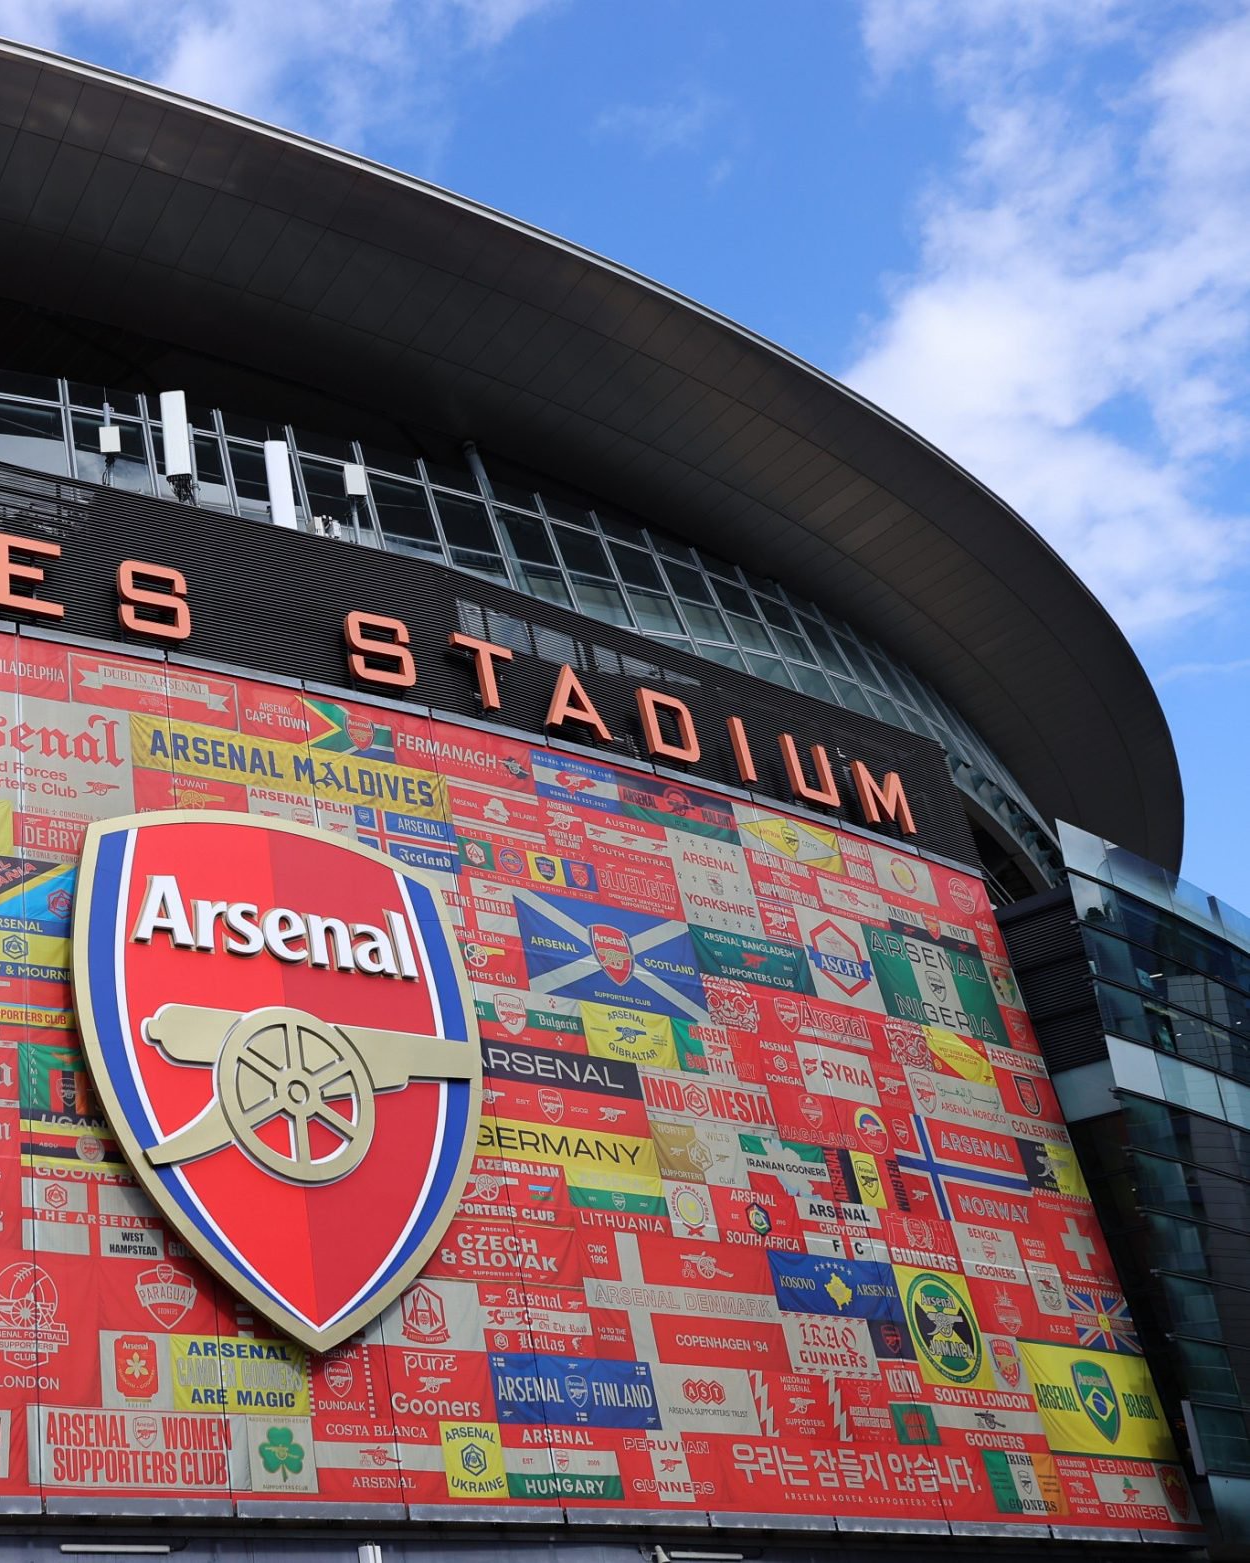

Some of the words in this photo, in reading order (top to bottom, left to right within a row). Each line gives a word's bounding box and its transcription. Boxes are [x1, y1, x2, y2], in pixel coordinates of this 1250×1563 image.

[344, 610, 917, 836] STADIUM
[397, 733, 497, 769] FERMANAGH
[13, 762, 67, 781] Forces
[150, 729, 283, 784] ARSENAL
[294, 756, 434, 807] MALDIVES
[41, 782, 78, 799] Club
[398, 818, 444, 837] ARSENAL
[683, 851, 739, 873] ARSENAL
[685, 893, 756, 918] YORKSHIRE
[129, 874, 420, 984] Arsenal
[531, 936, 579, 953] ARSENAL
[644, 958, 695, 975] SCOTLAND
[45, 1012, 66, 1024] CLUB
[894, 990, 997, 1041] NIGERIA
[609, 1042, 657, 1060] GIBRALTAR
[822, 1060, 873, 1088] SYRIA
[477, 1124, 641, 1167] GERMANY
[747, 1157, 784, 1172] IRANIAN
[786, 1165, 827, 1178] GOONERS
[959, 1195, 1030, 1225] NORWAY
[580, 1211, 665, 1233] LITHUANIA
[819, 1224, 868, 1237] CROYDON
[121, 1232, 145, 1243] WEST
[457, 1234, 538, 1254] CZECH
[726, 1231, 762, 1247] SOUTH
[764, 1236, 800, 1250] AFRICA
[110, 1243, 157, 1256] HAMPSTEAD
[188, 1341, 292, 1360] ARSENAL
[191, 1390, 228, 1405] ARE
[237, 1392, 295, 1408] MAGIC
[498, 1375, 565, 1404] ARSENAL
[593, 1382, 653, 1408] FINLAND
[934, 1388, 977, 1406] SOUTH
[982, 1392, 1029, 1410] LONDON
[1035, 1382, 1080, 1412] ARSENAL
[1123, 1393, 1159, 1420] BRASIL
[391, 1393, 480, 1418] Gooners
[47, 1412, 130, 1448] ARSENAL
[162, 1417, 232, 1450] WOMEN
[326, 1424, 369, 1437] COSTA
[374, 1425, 427, 1439] BLANCA
[623, 1438, 709, 1453] PERUVIAN
[53, 1449, 178, 1486] SUPPORTERS
[181, 1455, 227, 1485] CLUB
[732, 1443, 809, 1487] 우리는
[813, 1449, 886, 1490] 잠들지
[887, 1455, 982, 1492] 않습니다.
[1091, 1460, 1152, 1476] LEBANON
[452, 1476, 505, 1493] UKRAINE
[525, 1479, 604, 1494] HUNGARY
